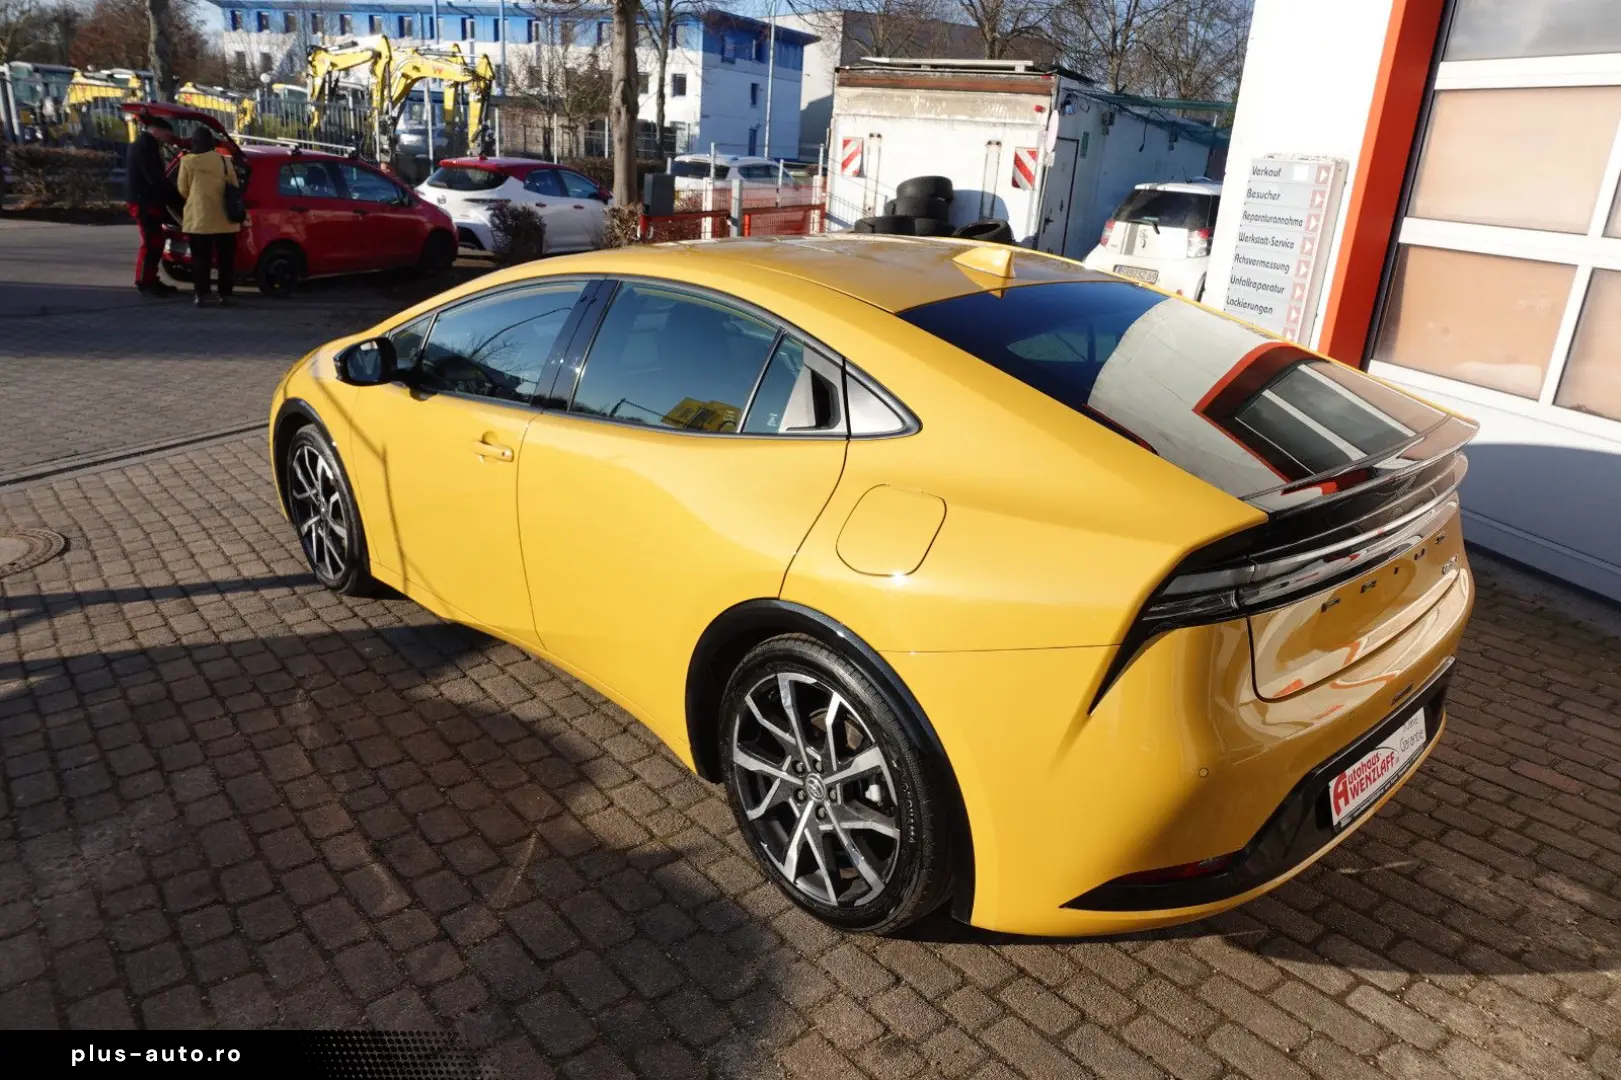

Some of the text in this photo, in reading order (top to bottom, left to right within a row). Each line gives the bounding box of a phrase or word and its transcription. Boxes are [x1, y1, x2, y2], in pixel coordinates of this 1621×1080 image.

[1252, 165, 1282, 177] Verkauf
[1246, 188, 1281, 201] Besucher
[1242, 210, 1304, 227] Reparaturannahme
[1238, 232, 1295, 249] Werkstatt-Service
[1234, 253, 1290, 274] Achsvermessung
[1230, 274, 1285, 294] Unfallreparatur
[1226, 295, 1273, 315] Lackierungen
[1333, 752, 1381, 816] Autohaus
[1349, 751, 1395, 800] WENZLAFF
